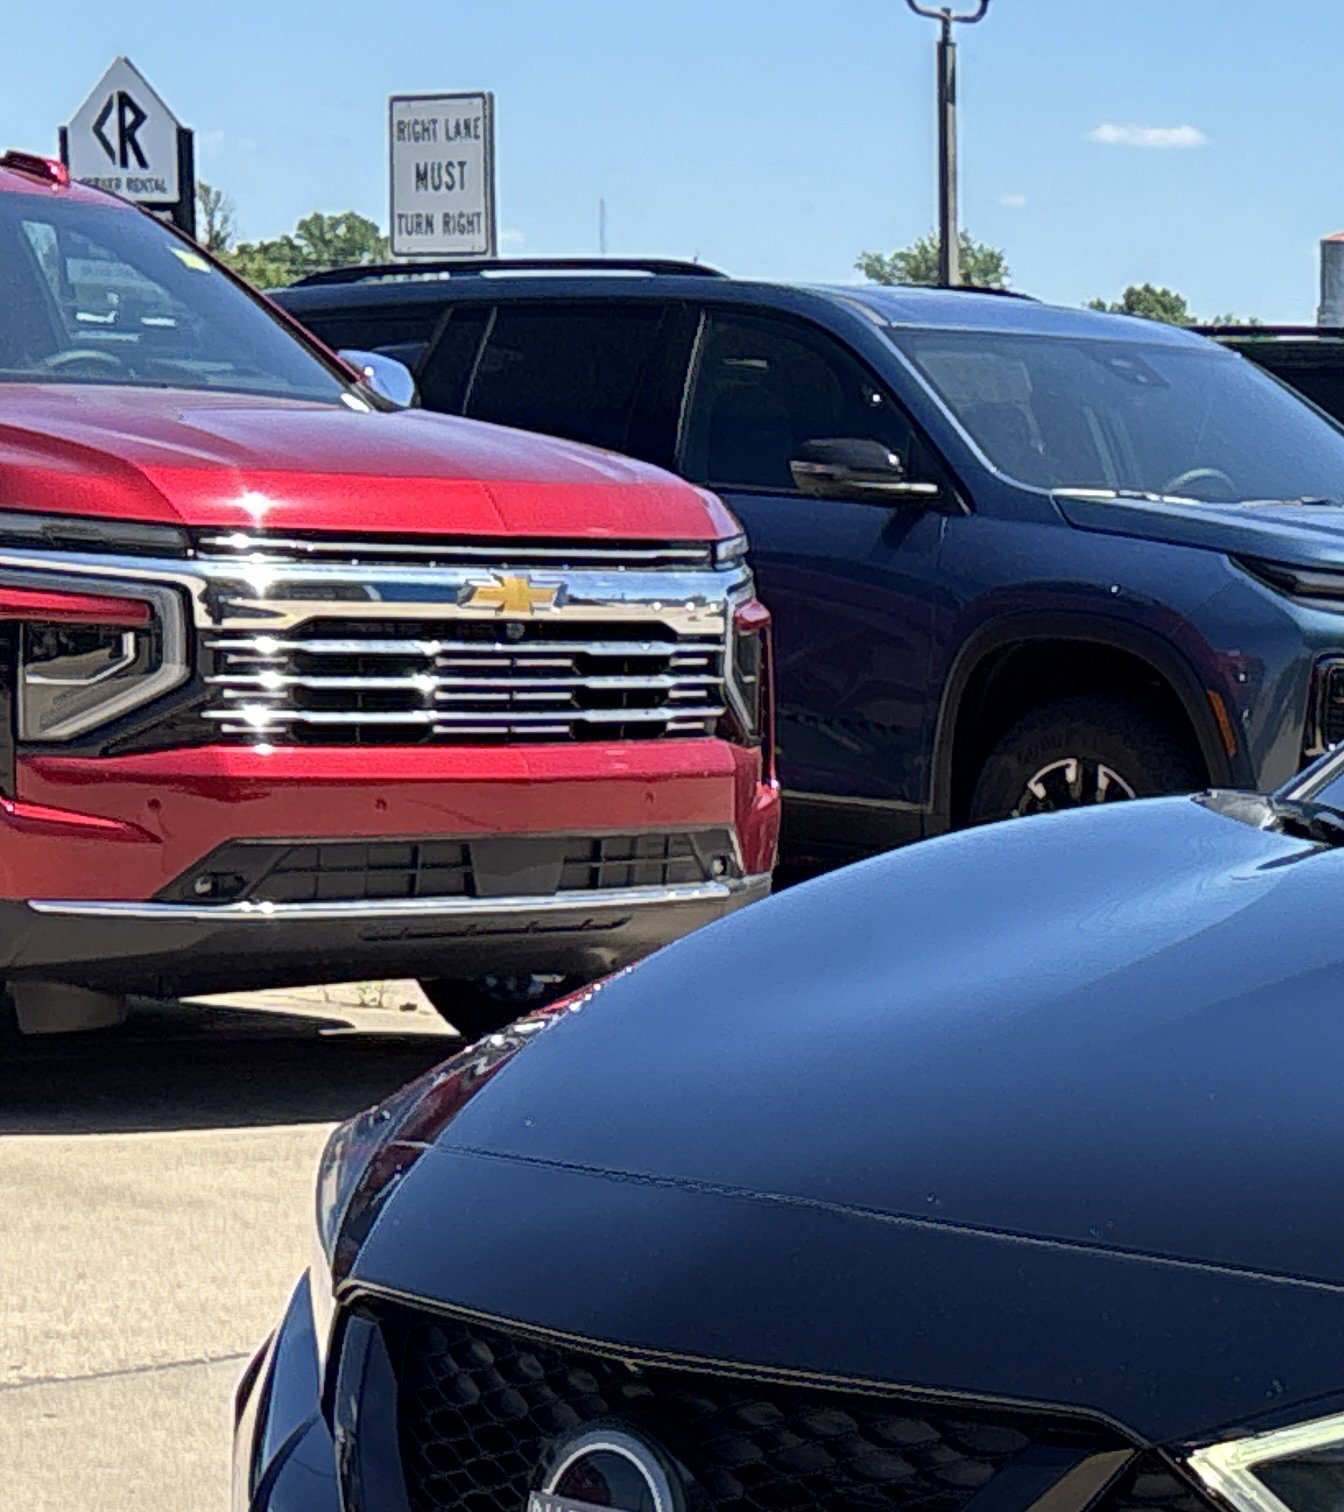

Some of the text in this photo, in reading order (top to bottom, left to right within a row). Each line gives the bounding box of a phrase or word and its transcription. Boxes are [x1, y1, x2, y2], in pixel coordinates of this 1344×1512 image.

[396, 116, 481, 143] RIGHT LANE
[415, 160, 467, 192] MUST
[397, 211, 482, 237] TURN RIGHT
